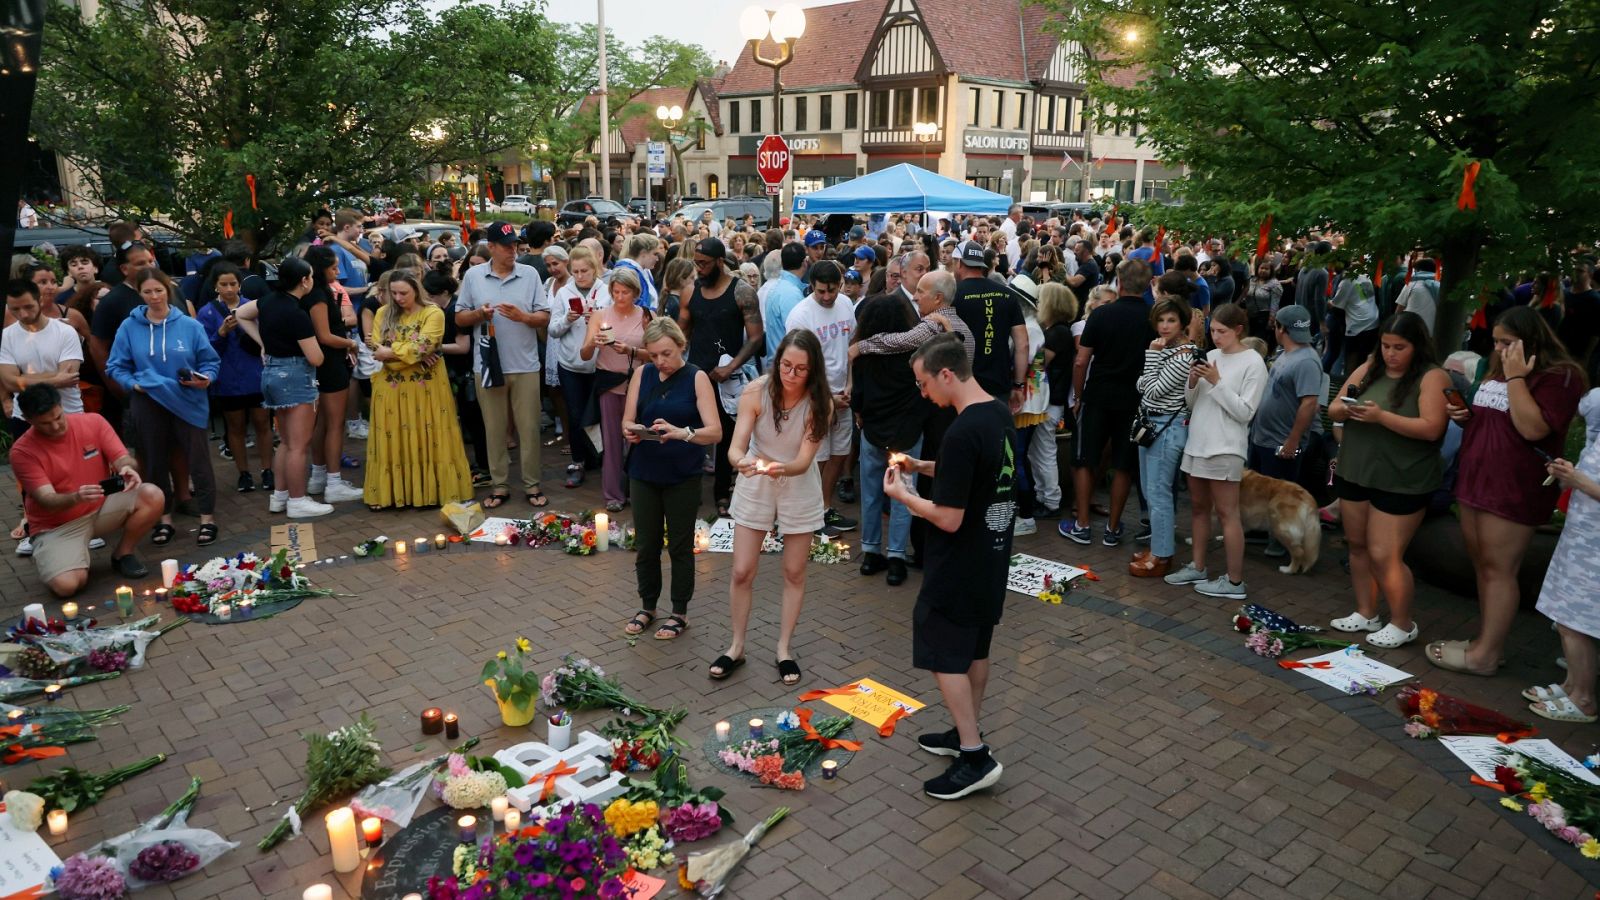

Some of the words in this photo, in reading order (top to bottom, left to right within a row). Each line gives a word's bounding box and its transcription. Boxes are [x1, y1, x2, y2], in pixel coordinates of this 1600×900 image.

[790, 138, 820, 150] LOFTS
[965, 135, 998, 149] SALON
[1000, 137, 1028, 150] LOFTS
[760, 151, 788, 169] STOP
[984, 299, 994, 355] UNTAMED
